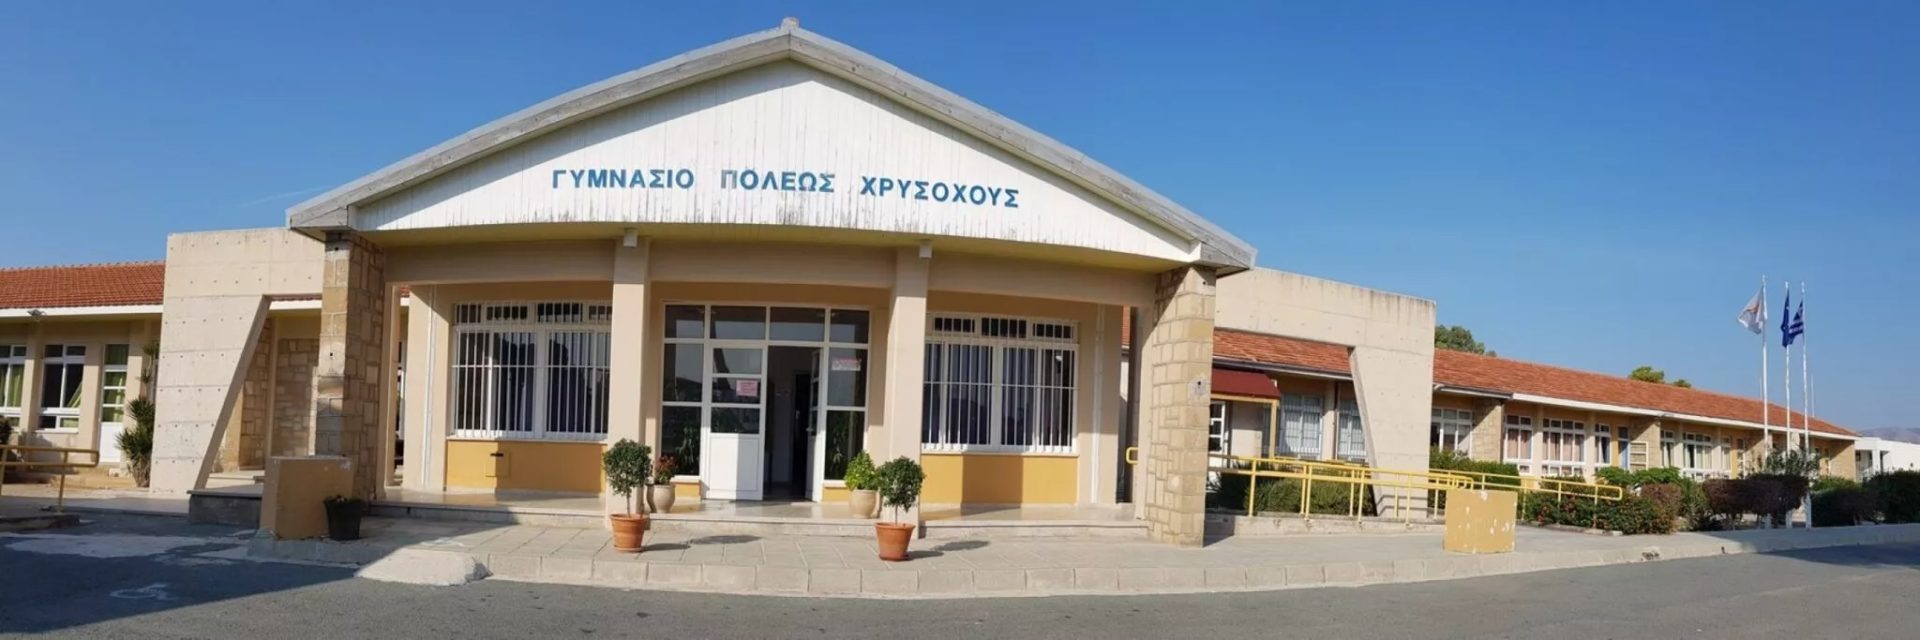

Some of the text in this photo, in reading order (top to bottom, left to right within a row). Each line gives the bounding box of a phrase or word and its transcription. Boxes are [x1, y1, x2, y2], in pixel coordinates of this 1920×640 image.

[552, 169, 1019, 208] ΓΥΜΝΑΣΙΟ ΠΟΛΕΩΣ ΧΡΥΣΟΧΟΥΣ
